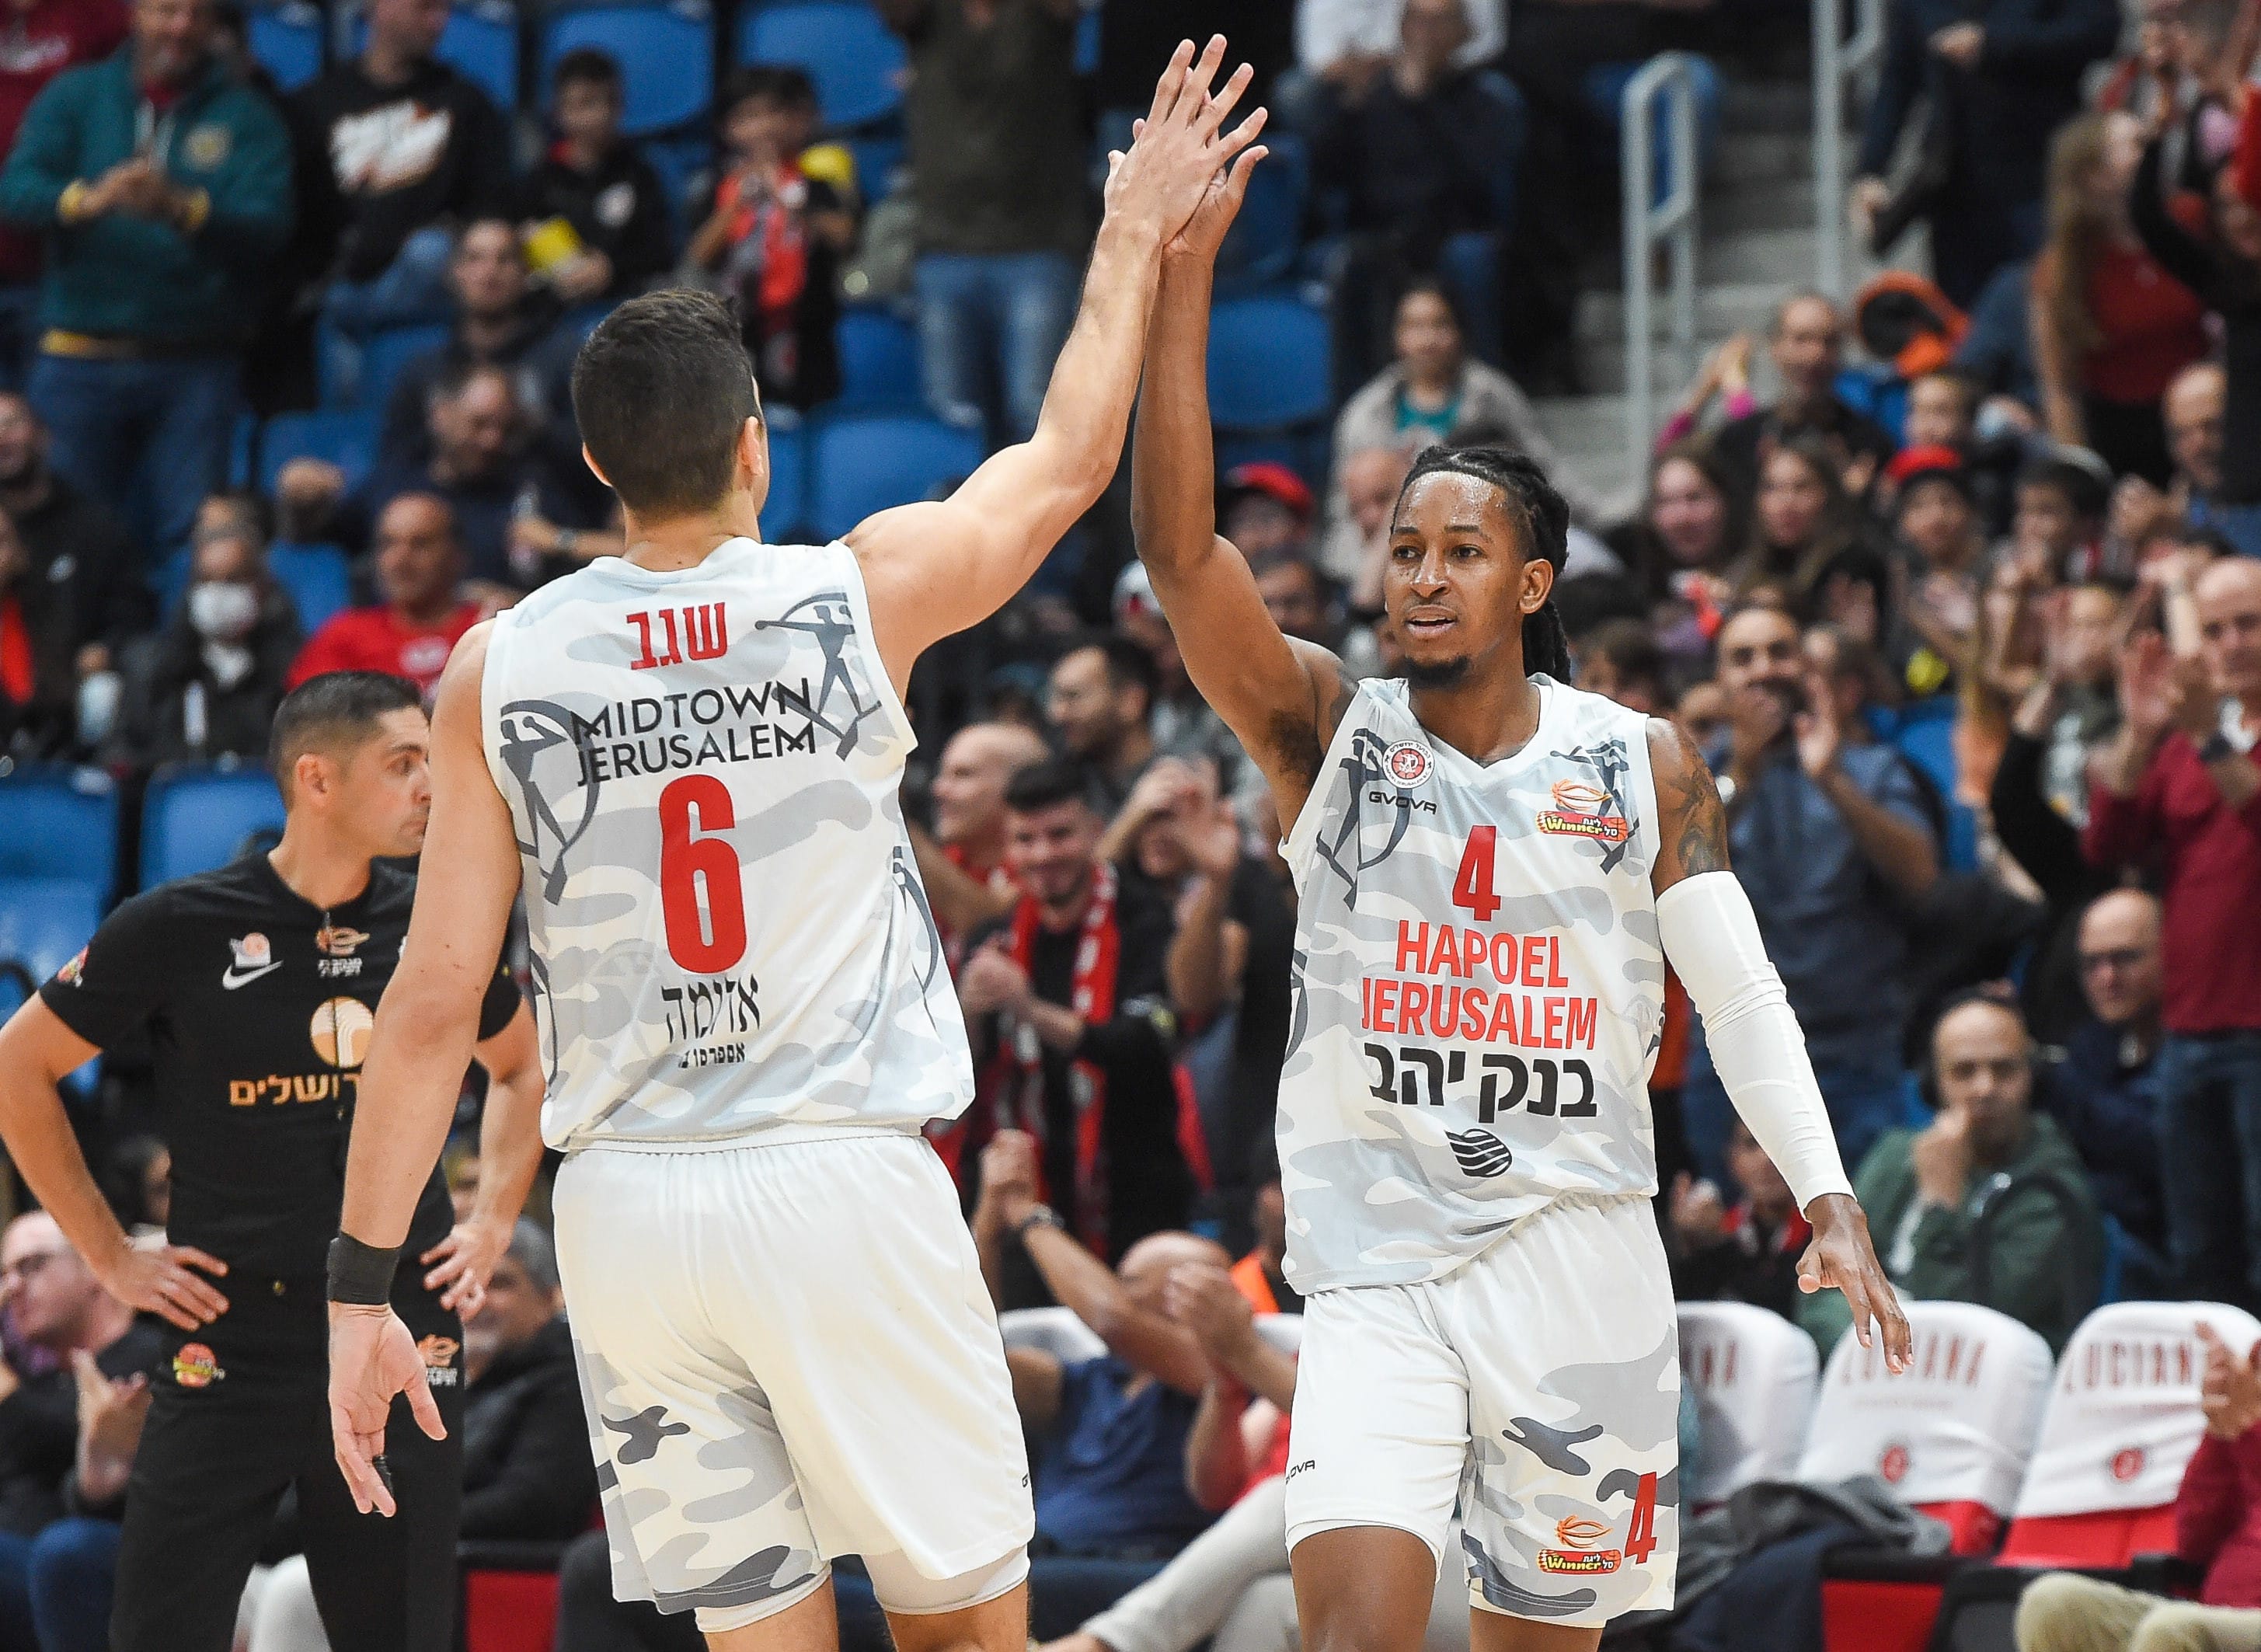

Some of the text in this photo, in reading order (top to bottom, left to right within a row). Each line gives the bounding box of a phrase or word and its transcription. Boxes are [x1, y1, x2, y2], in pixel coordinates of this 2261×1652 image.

[626, 602, 727, 670] שגב
[570, 678, 812, 744] MIDTOWN
[577, 720, 816, 786] JERUSALEM
[1545, 816, 1618, 837] Winner סל
[659, 774, 746, 974] 6
[1452, 825, 1501, 922] 4
[1395, 920, 1568, 988] HAPOEL
[1362, 978, 1597, 1050] JERUSALEM
[229, 1073, 362, 1107] רושלים
[1364, 1043, 1597, 1124] בנק יהב
[1625, 1472, 1658, 1564] 4
[1547, 1554, 1615, 1570] Winner סל
[1583, 1553, 1601, 1563] ליגת
